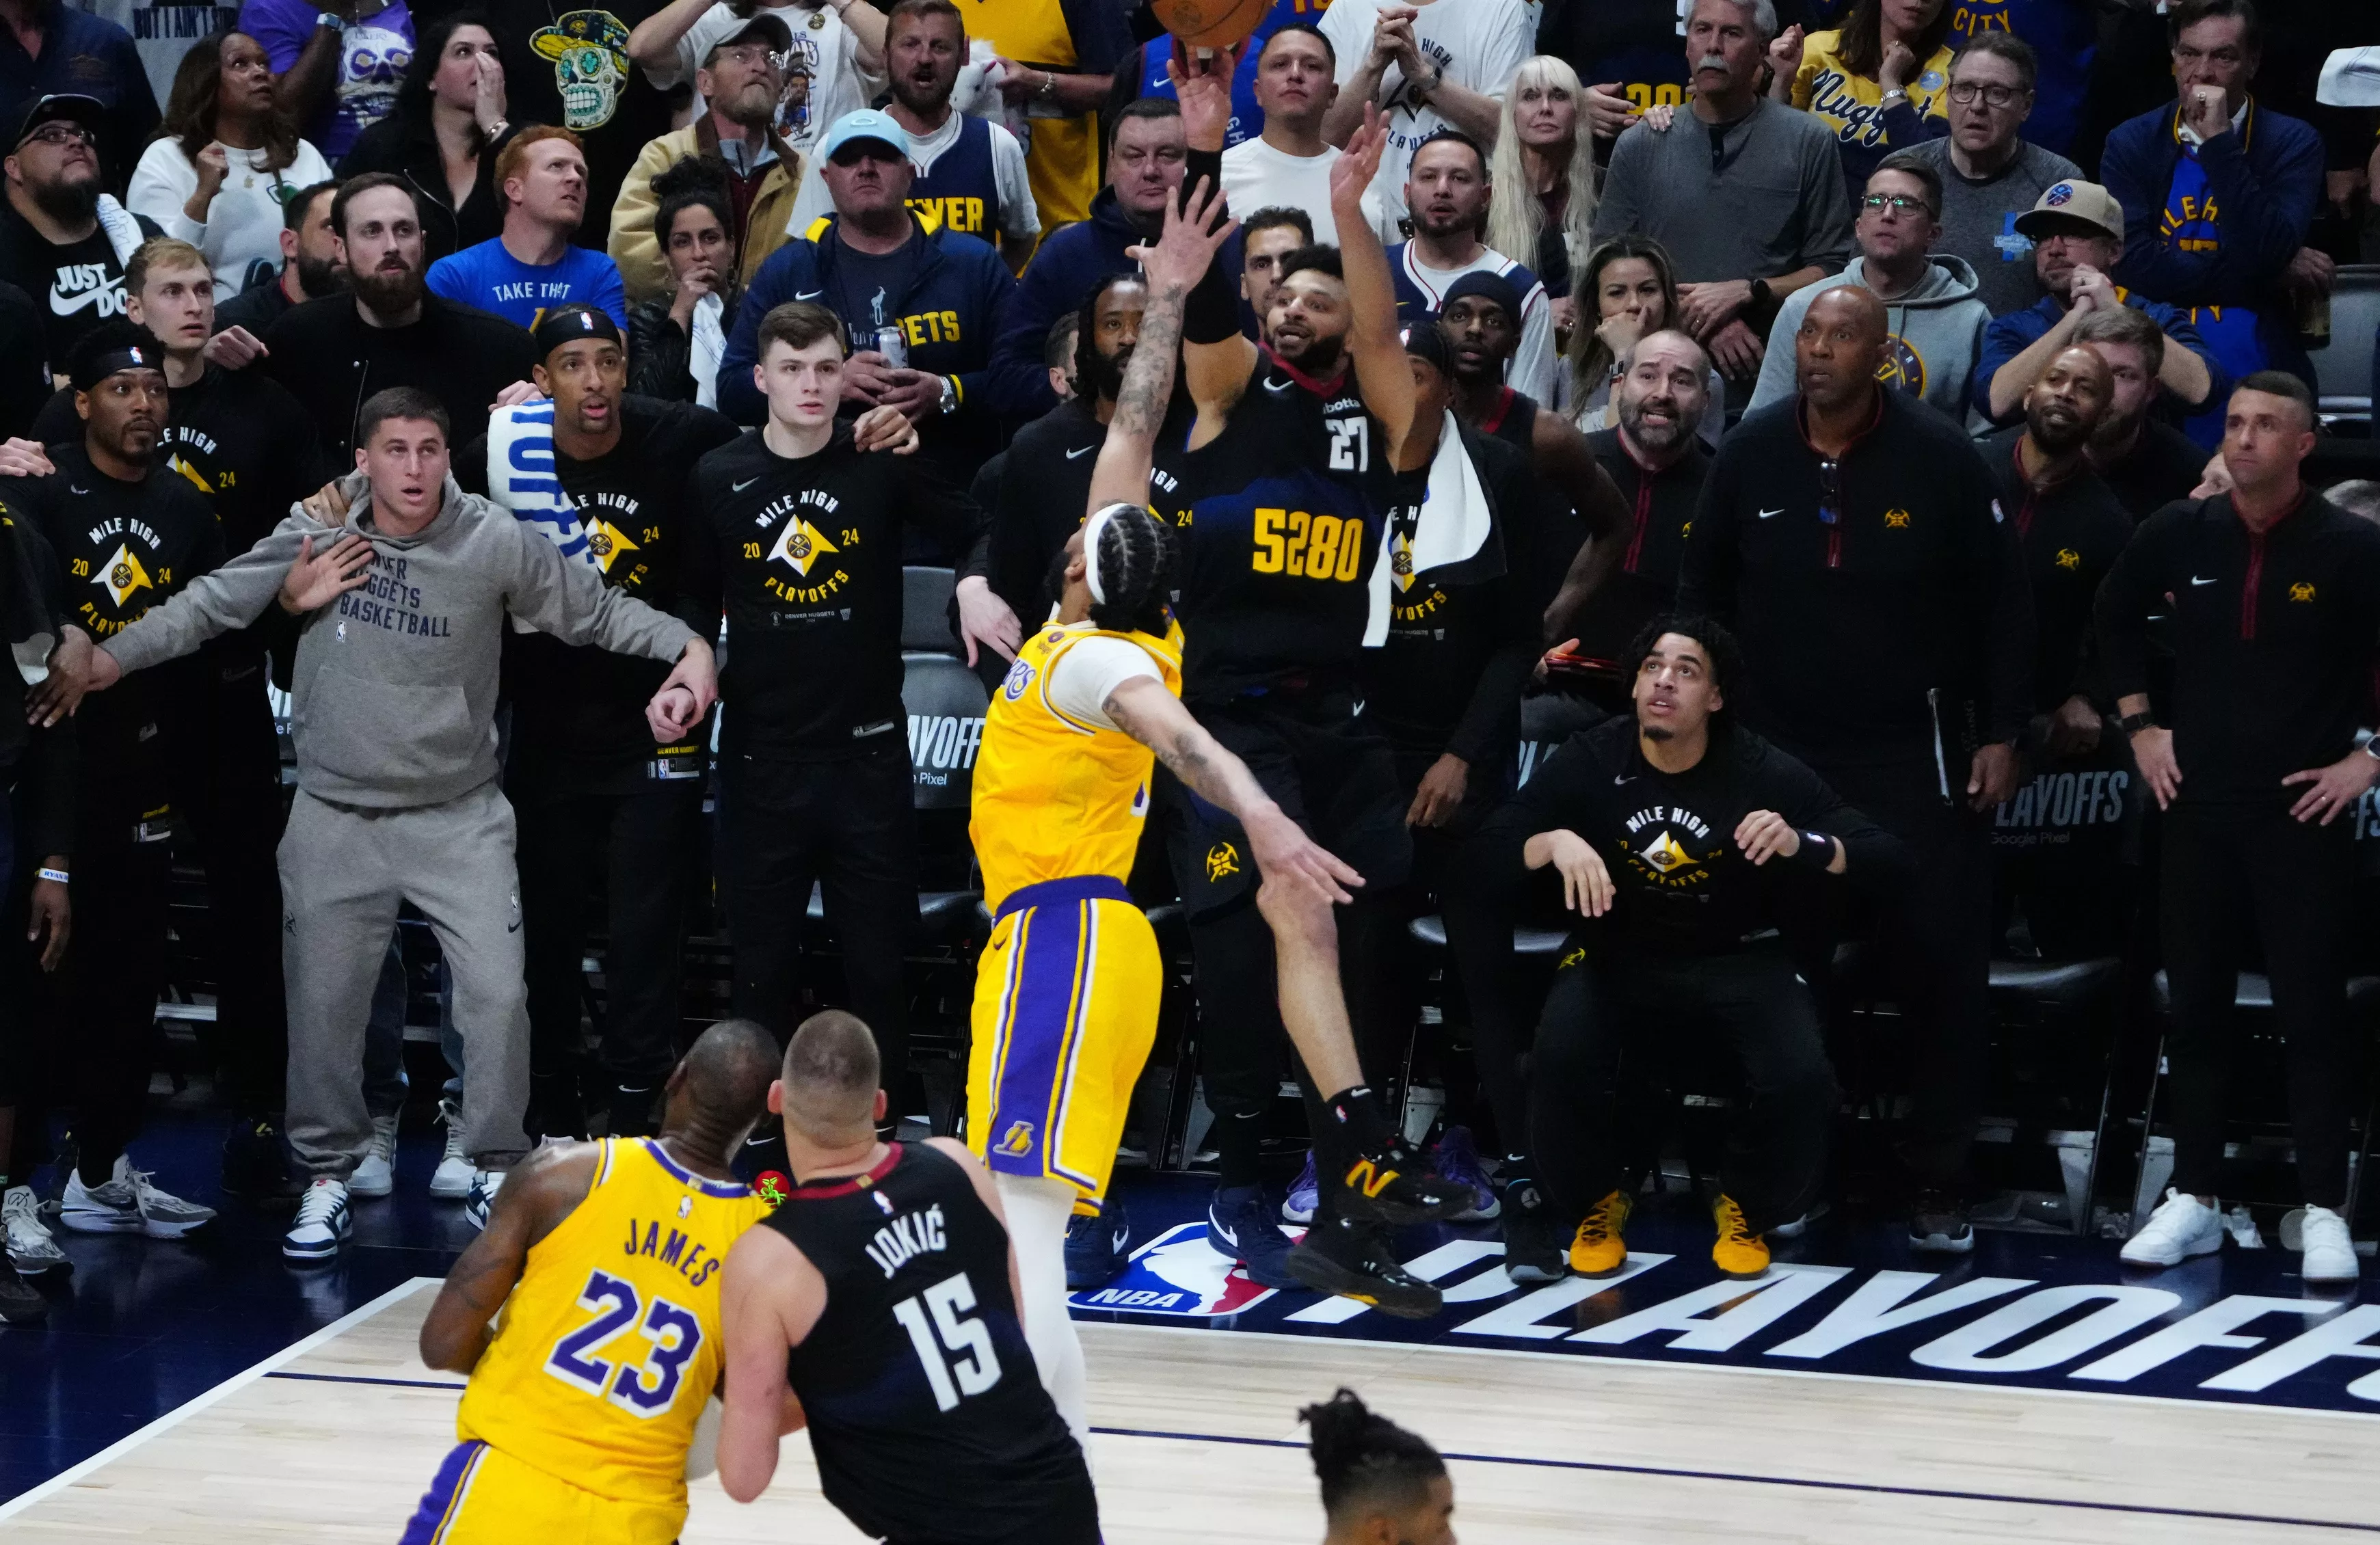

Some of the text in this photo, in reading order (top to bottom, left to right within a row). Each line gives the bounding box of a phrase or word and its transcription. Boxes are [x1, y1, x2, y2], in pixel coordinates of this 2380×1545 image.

[133, 8, 159, 39] BUT
[1953, 6, 2011, 37] CITY
[1421, 38, 1452, 66] HIGH
[55, 263, 105, 293] JUST
[492, 282, 572, 302] TAKE THAT
[96, 287, 128, 317] DO
[179, 426, 217, 455] HIGH
[1325, 416, 1368, 473] 27
[219, 471, 236, 487] 24
[598, 492, 639, 515] HIGH
[756, 489, 840, 528] MILE HIGH
[1177, 509, 1193, 526] 24
[88, 517, 161, 550] MILE HIGH
[643, 525, 659, 543] 24
[842, 528, 859, 546] 24
[1252, 507, 1364, 582] 5280
[743, 542, 760, 559] 20
[71, 558, 89, 576] 20
[158, 567, 171, 583] 24
[764, 569, 849, 603] PLAYOFFS
[340, 593, 451, 638] BASKETBALL
[920, 772, 948, 785] Pixel
[1626, 806, 1710, 839] MILE HIGH
[2040, 831, 2070, 846] Pixel
[624, 1218, 720, 1287] JAMES
[865, 1203, 947, 1280] JOKIĆ
[1087, 1288, 1184, 1308] NBA
[1283, 1239, 2380, 1401] PLAYOFF
[543, 1267, 704, 1420] 23
[892, 1271, 1003, 1413] 15
